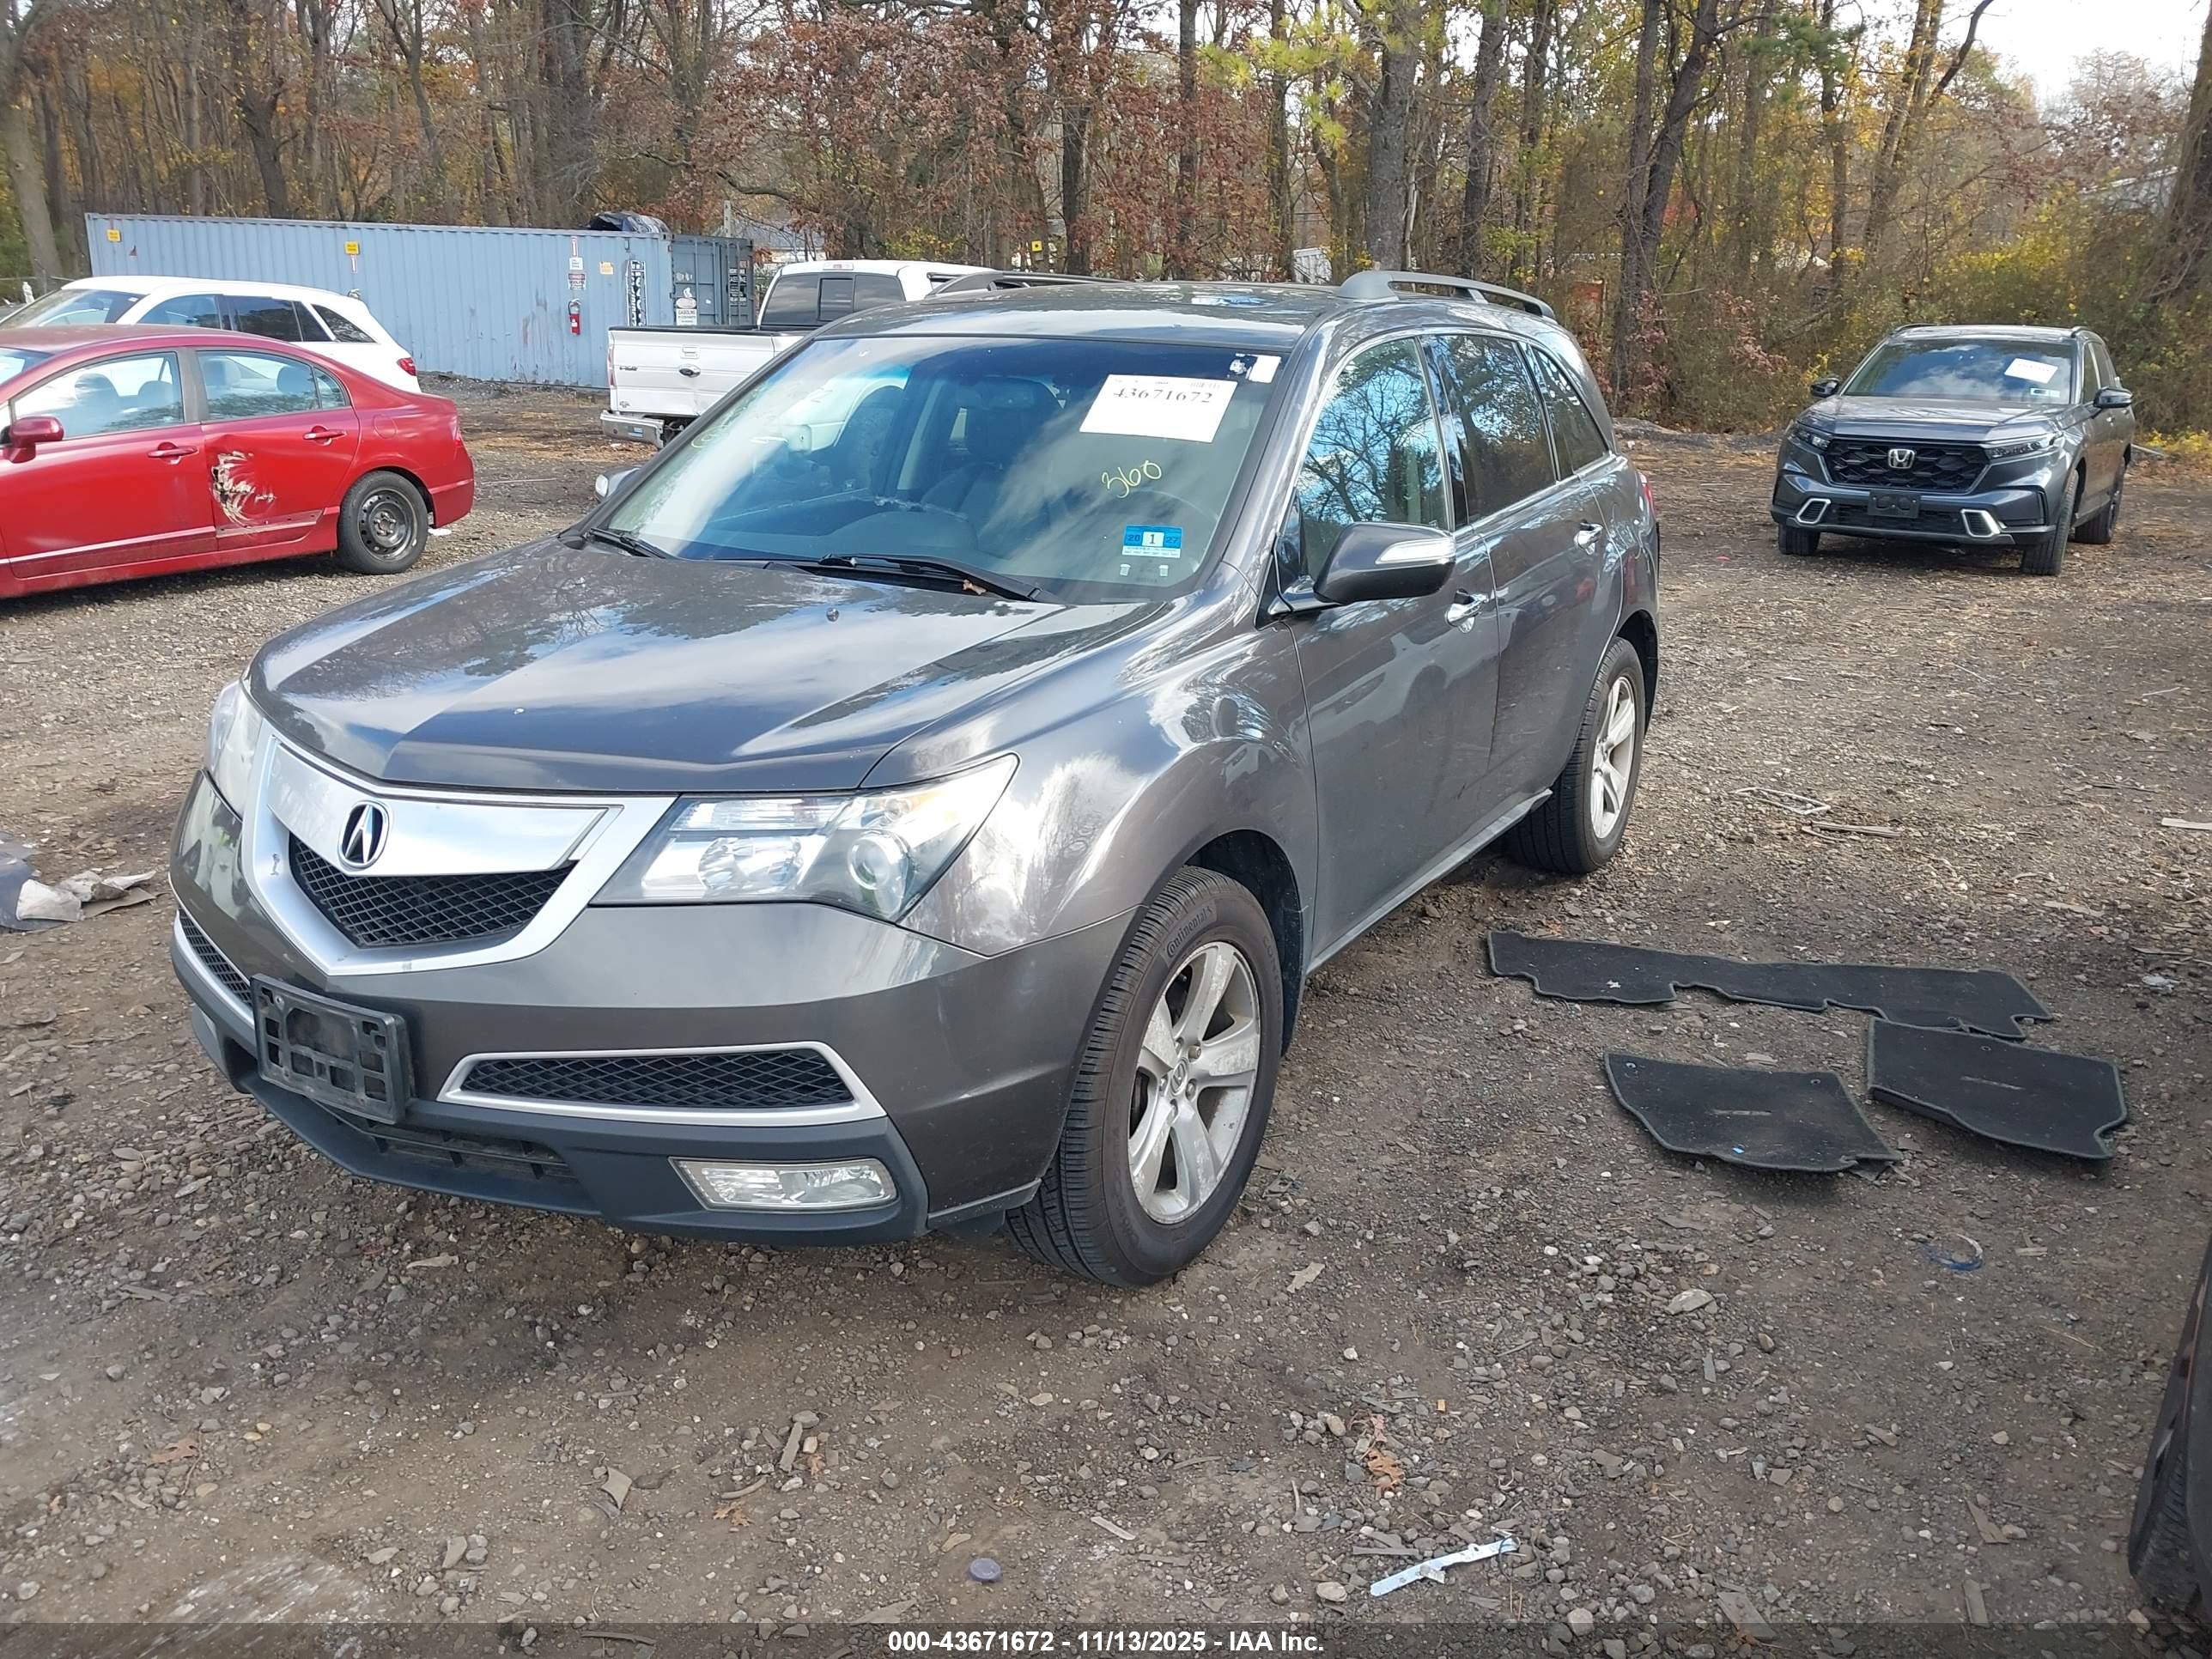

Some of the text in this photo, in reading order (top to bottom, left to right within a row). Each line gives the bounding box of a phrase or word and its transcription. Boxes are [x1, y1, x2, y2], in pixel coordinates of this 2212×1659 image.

[1114, 387, 1212, 403] 43671672
[1102, 460, 1162, 498] 360
[1127, 533, 1178, 545] 20 1 27
[1166, 906, 1208, 958] Continental
